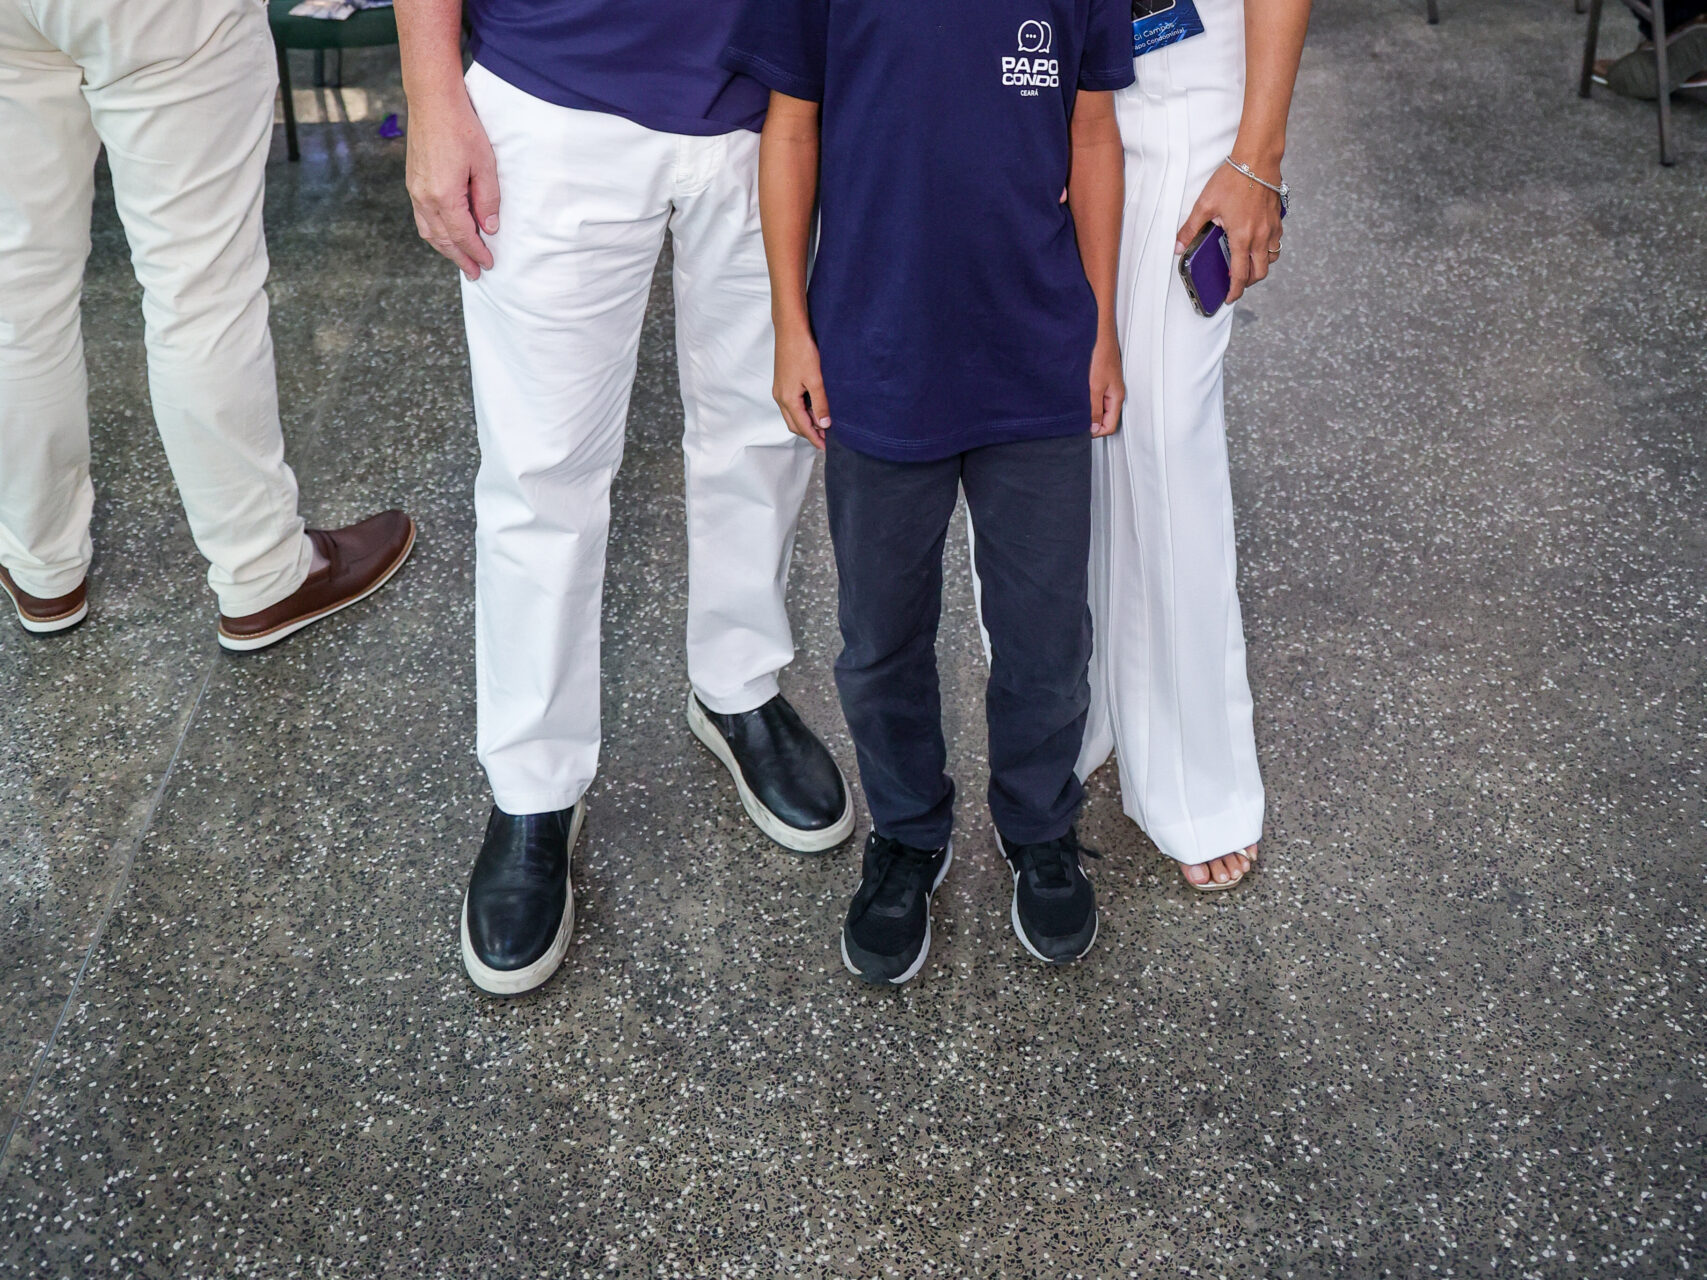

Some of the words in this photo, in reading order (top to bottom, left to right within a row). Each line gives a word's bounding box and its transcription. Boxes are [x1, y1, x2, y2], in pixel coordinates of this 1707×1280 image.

[1143, 22, 1175, 37] Campos
[1135, 42, 1146, 50] apo
[1001, 56, 1059, 75] PAPO
[1002, 72, 1059, 88] CONDO
[1020, 88, 1039, 97] CEARÁ
